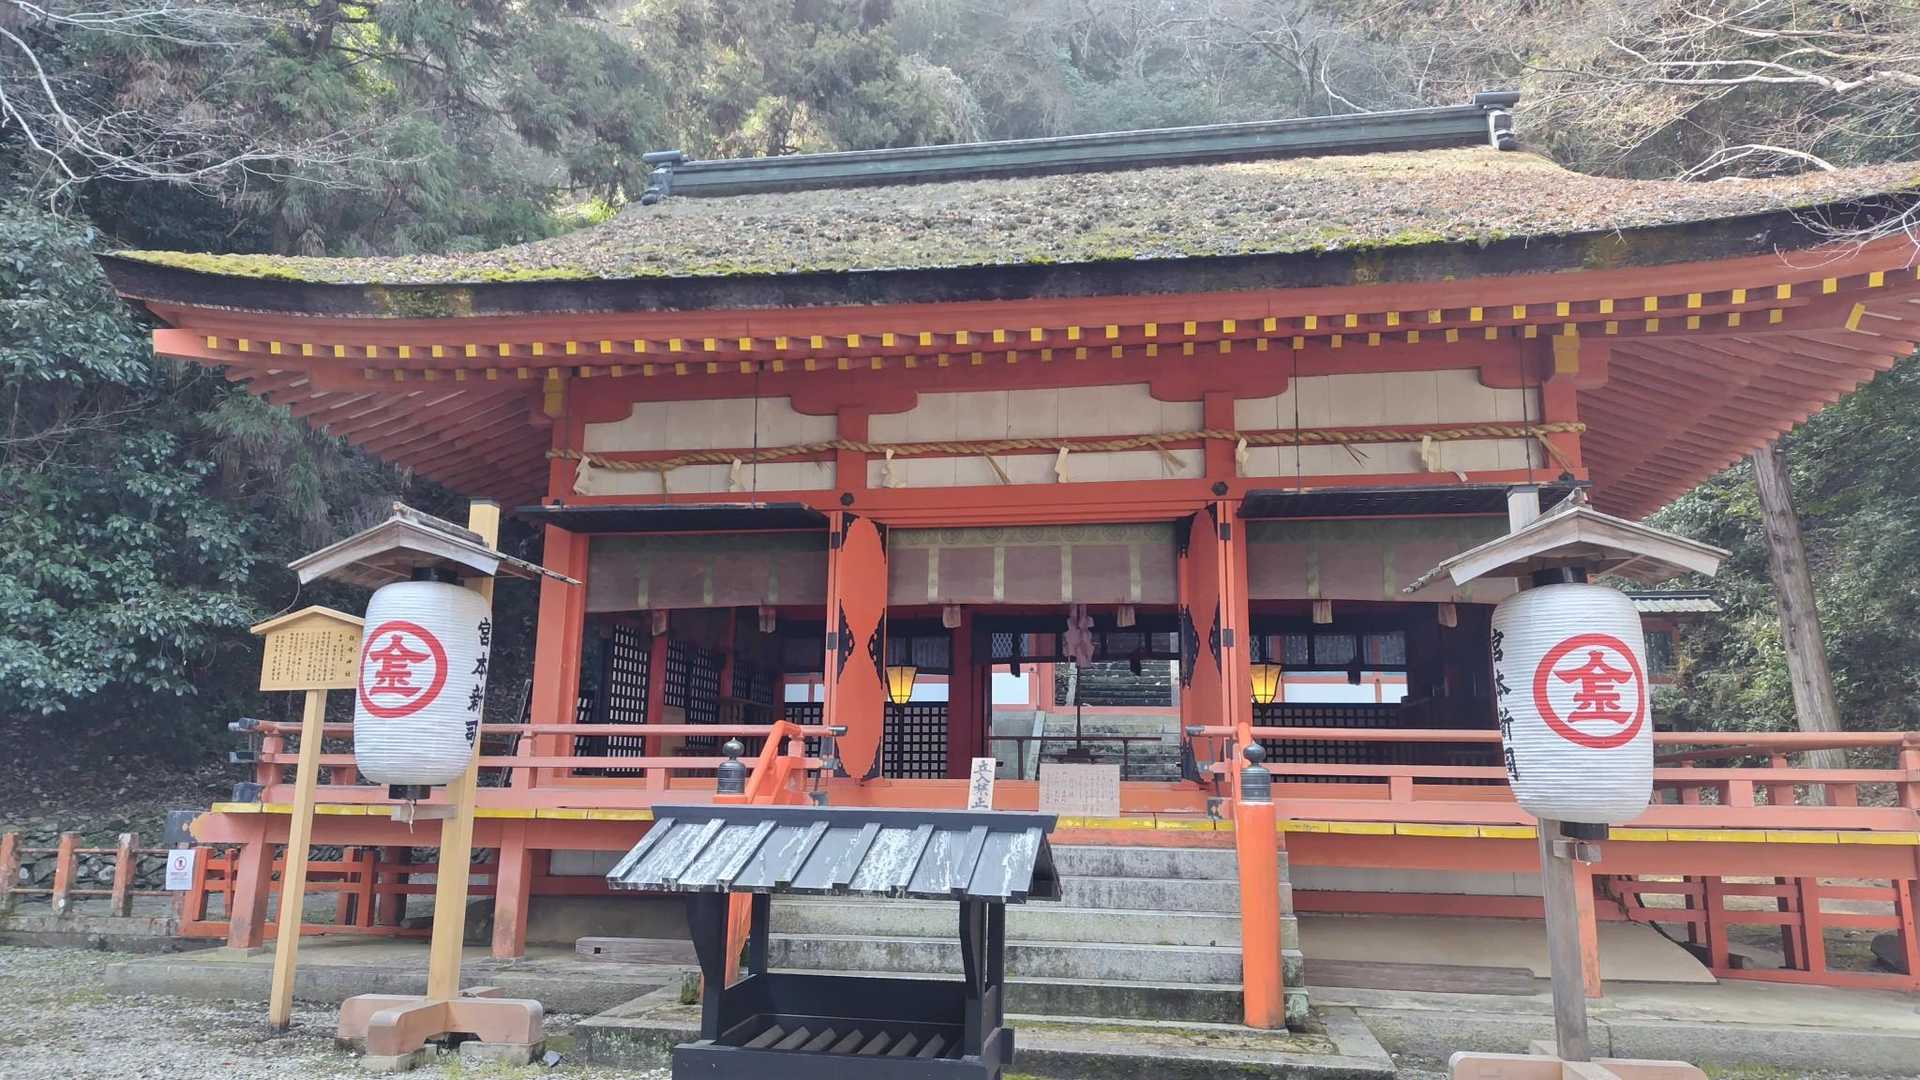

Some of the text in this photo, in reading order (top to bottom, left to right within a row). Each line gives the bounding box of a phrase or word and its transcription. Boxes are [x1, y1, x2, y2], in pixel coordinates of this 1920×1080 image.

[369, 634, 431, 698] 金
[1553, 650, 1633, 724] 金
[972, 759, 992, 809] 立入禁止
